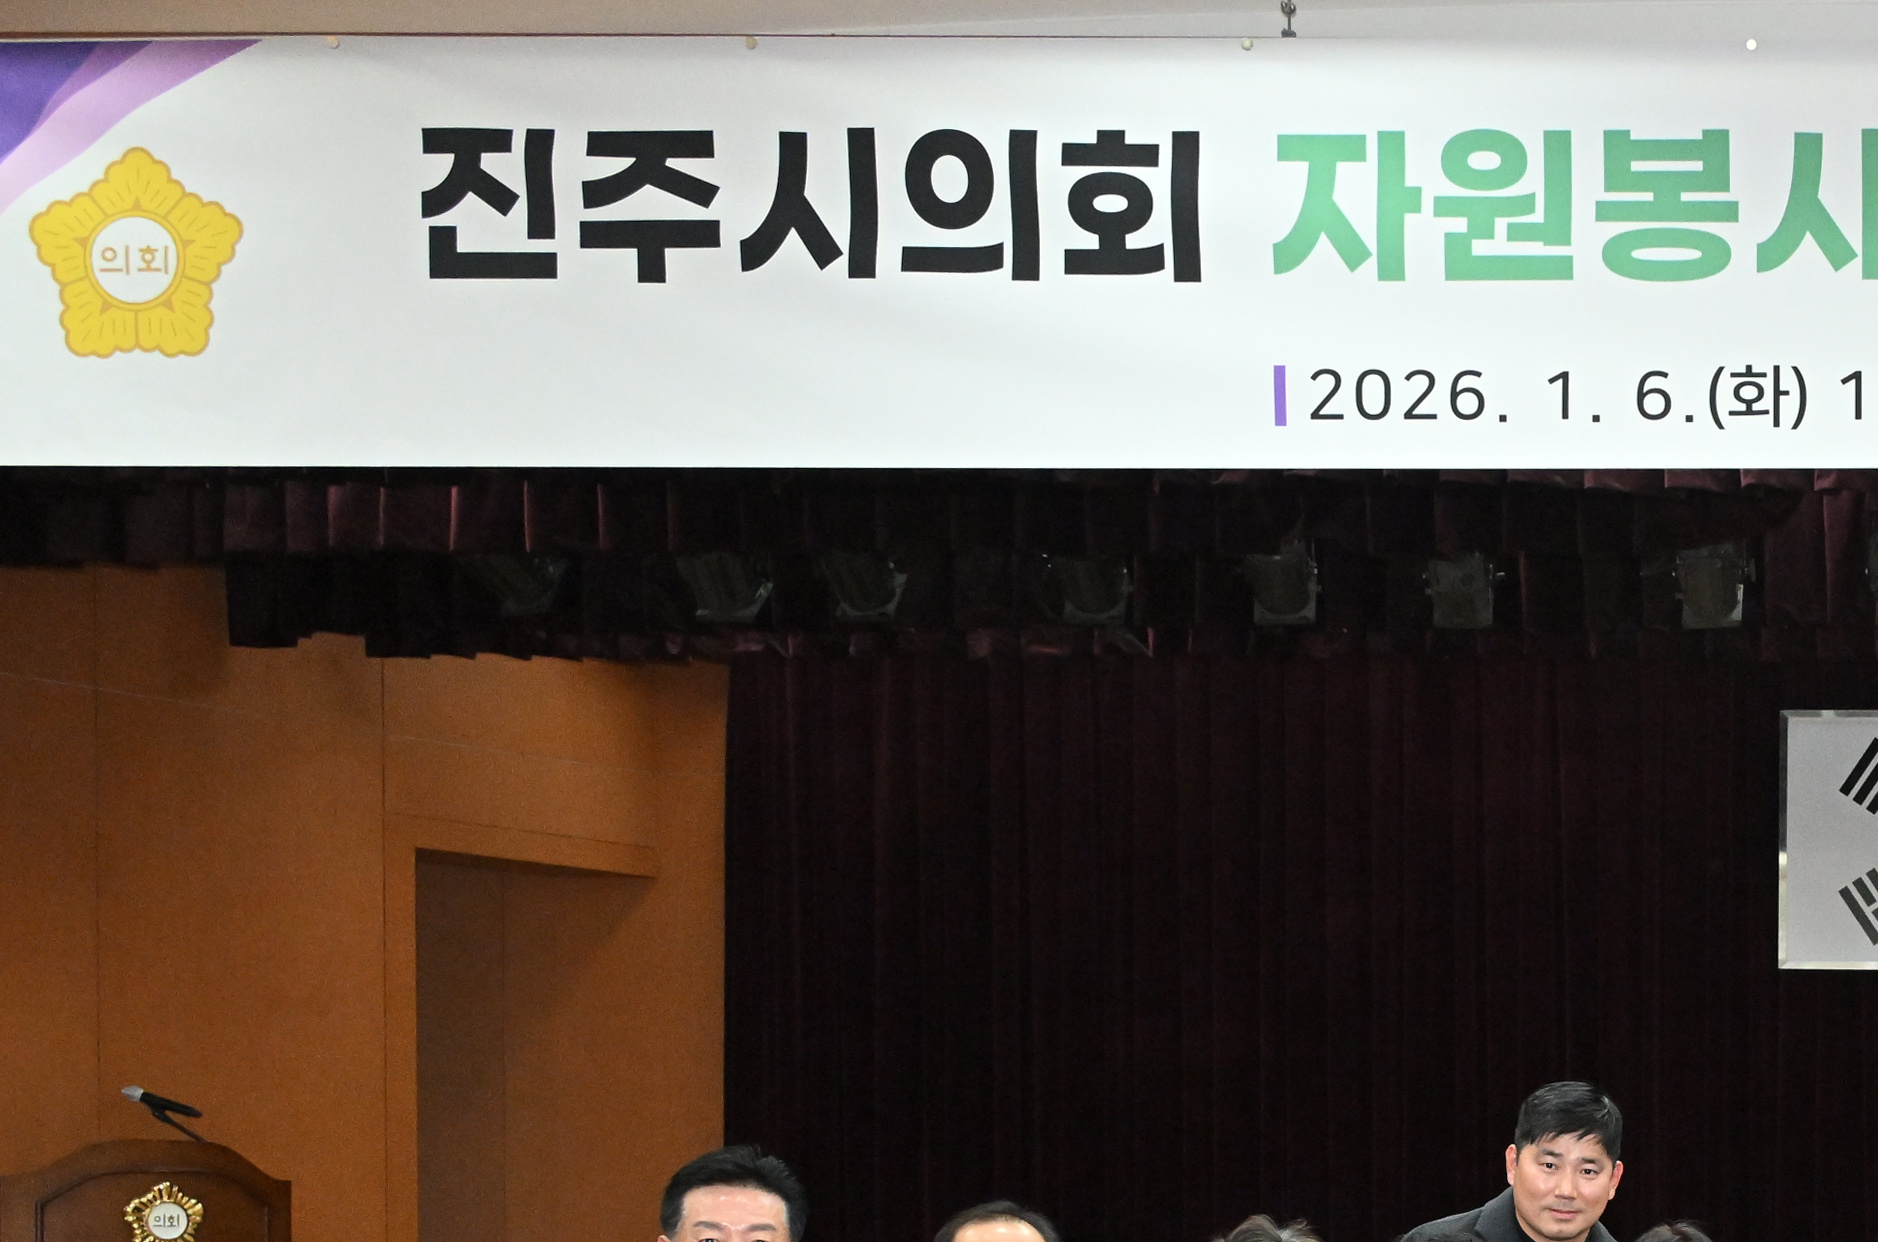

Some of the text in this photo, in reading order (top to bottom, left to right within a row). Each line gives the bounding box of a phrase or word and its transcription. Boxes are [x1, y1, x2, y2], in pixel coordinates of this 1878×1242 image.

[421, 126, 1202, 284] 진주시의회
[99, 245, 169, 275] 의회
[1310, 368, 1507, 423] 2026.
[1548, 371, 1601, 423] 1.
[153, 1213, 180, 1228] 의회
